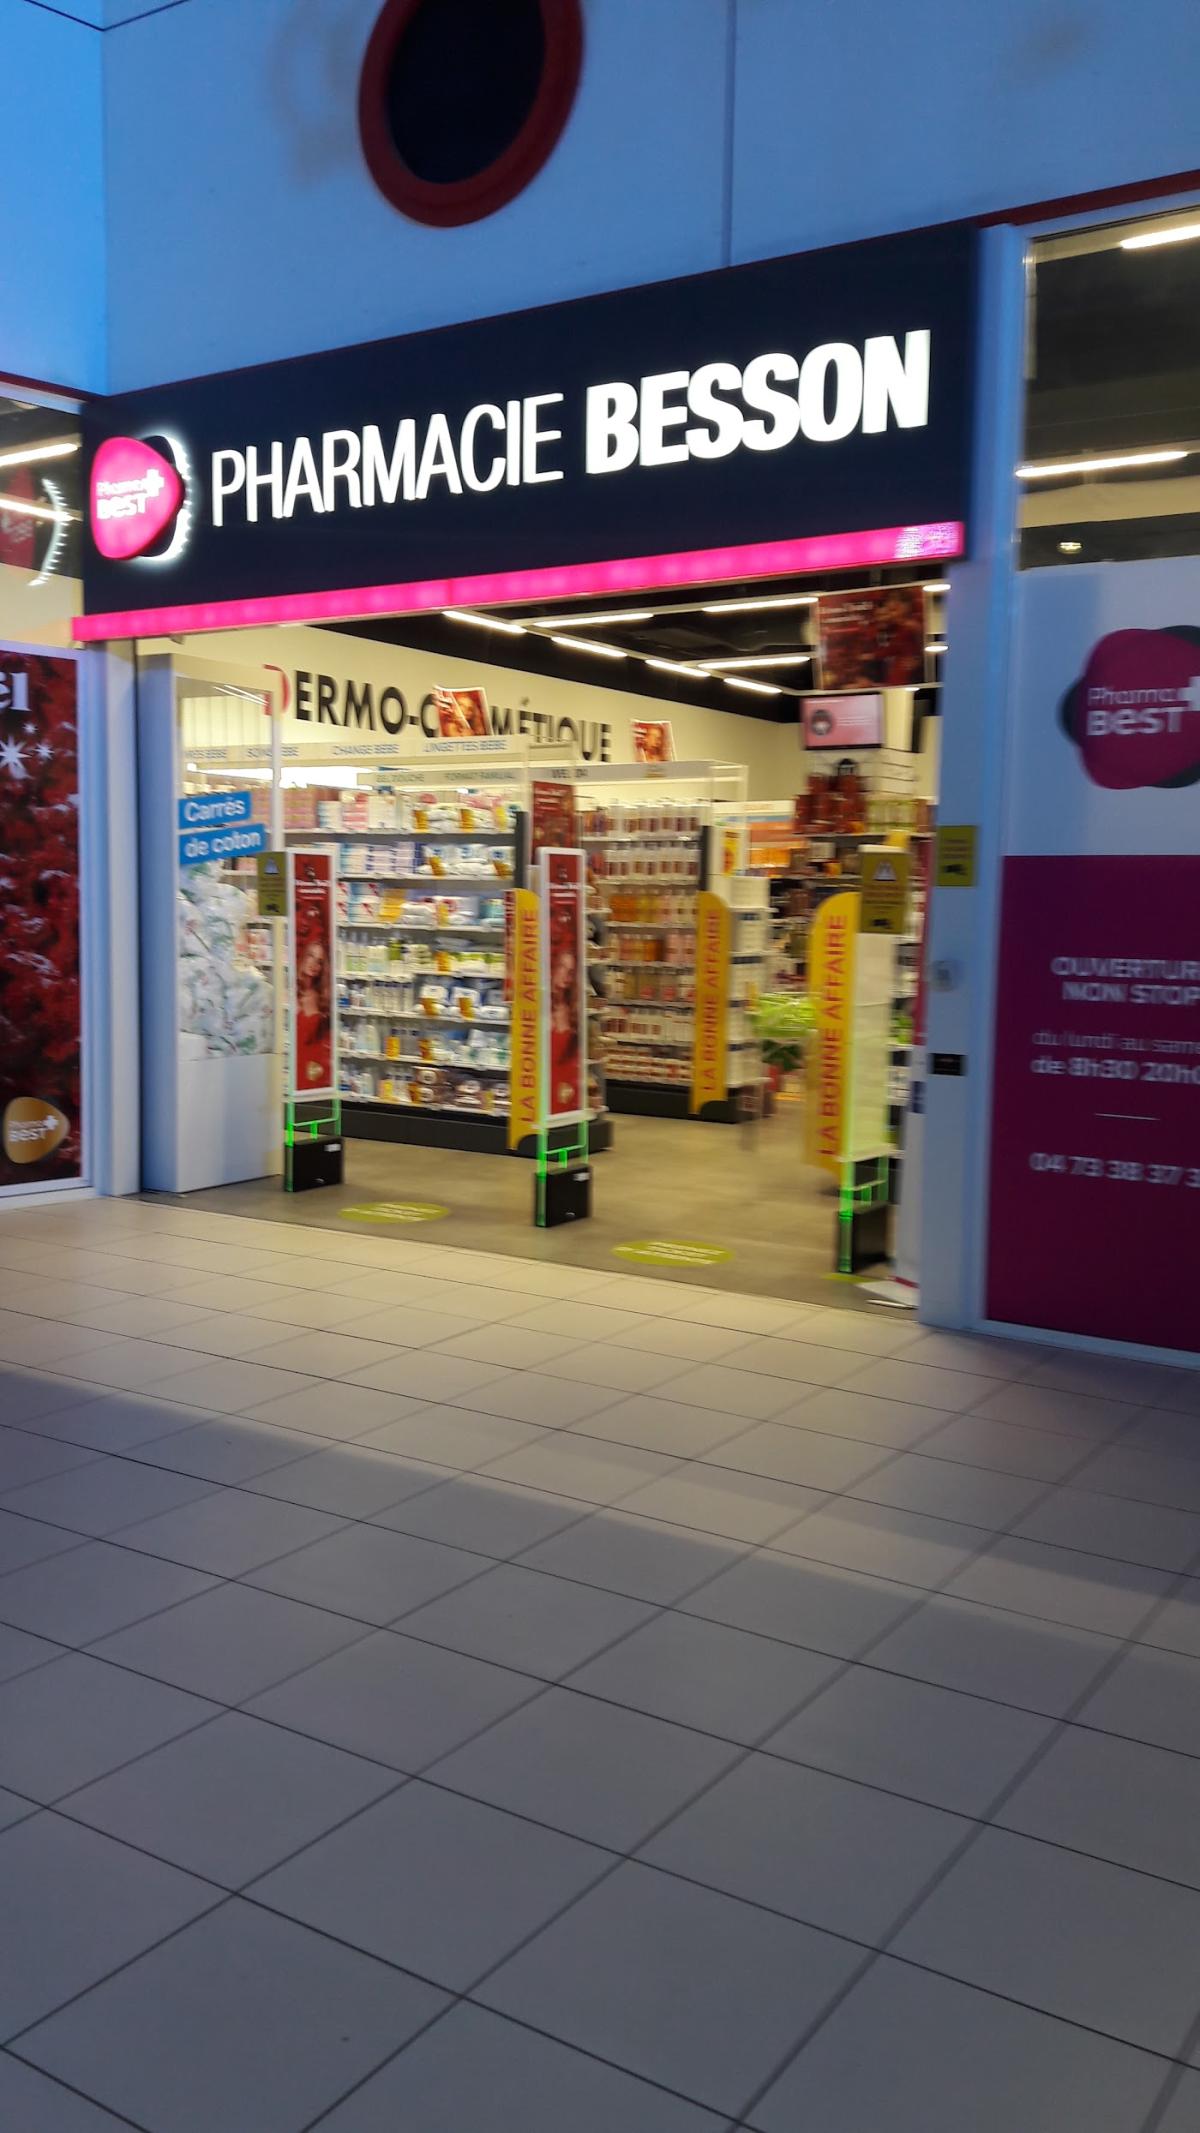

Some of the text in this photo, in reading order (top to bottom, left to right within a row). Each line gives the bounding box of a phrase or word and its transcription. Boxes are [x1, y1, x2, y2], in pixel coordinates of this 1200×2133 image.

[211, 329, 931, 527] PHARMACIE BESSON
[184, 796, 246, 822] Carrés
[184, 831, 262, 858] de coton
[520, 908, 539, 1004] AFFAIRE
[1062, 981, 1127, 1003] NON
[815, 914, 848, 1157] LA BONNE AFFAIRE
[1062, 1031, 1116, 1050] lundi
[1120, 1037, 1148, 1051] au
[519, 1009, 537, 1090] BONNE
[1030, 1055, 1066, 1075] de
[1029, 1152, 1067, 1173] 04
